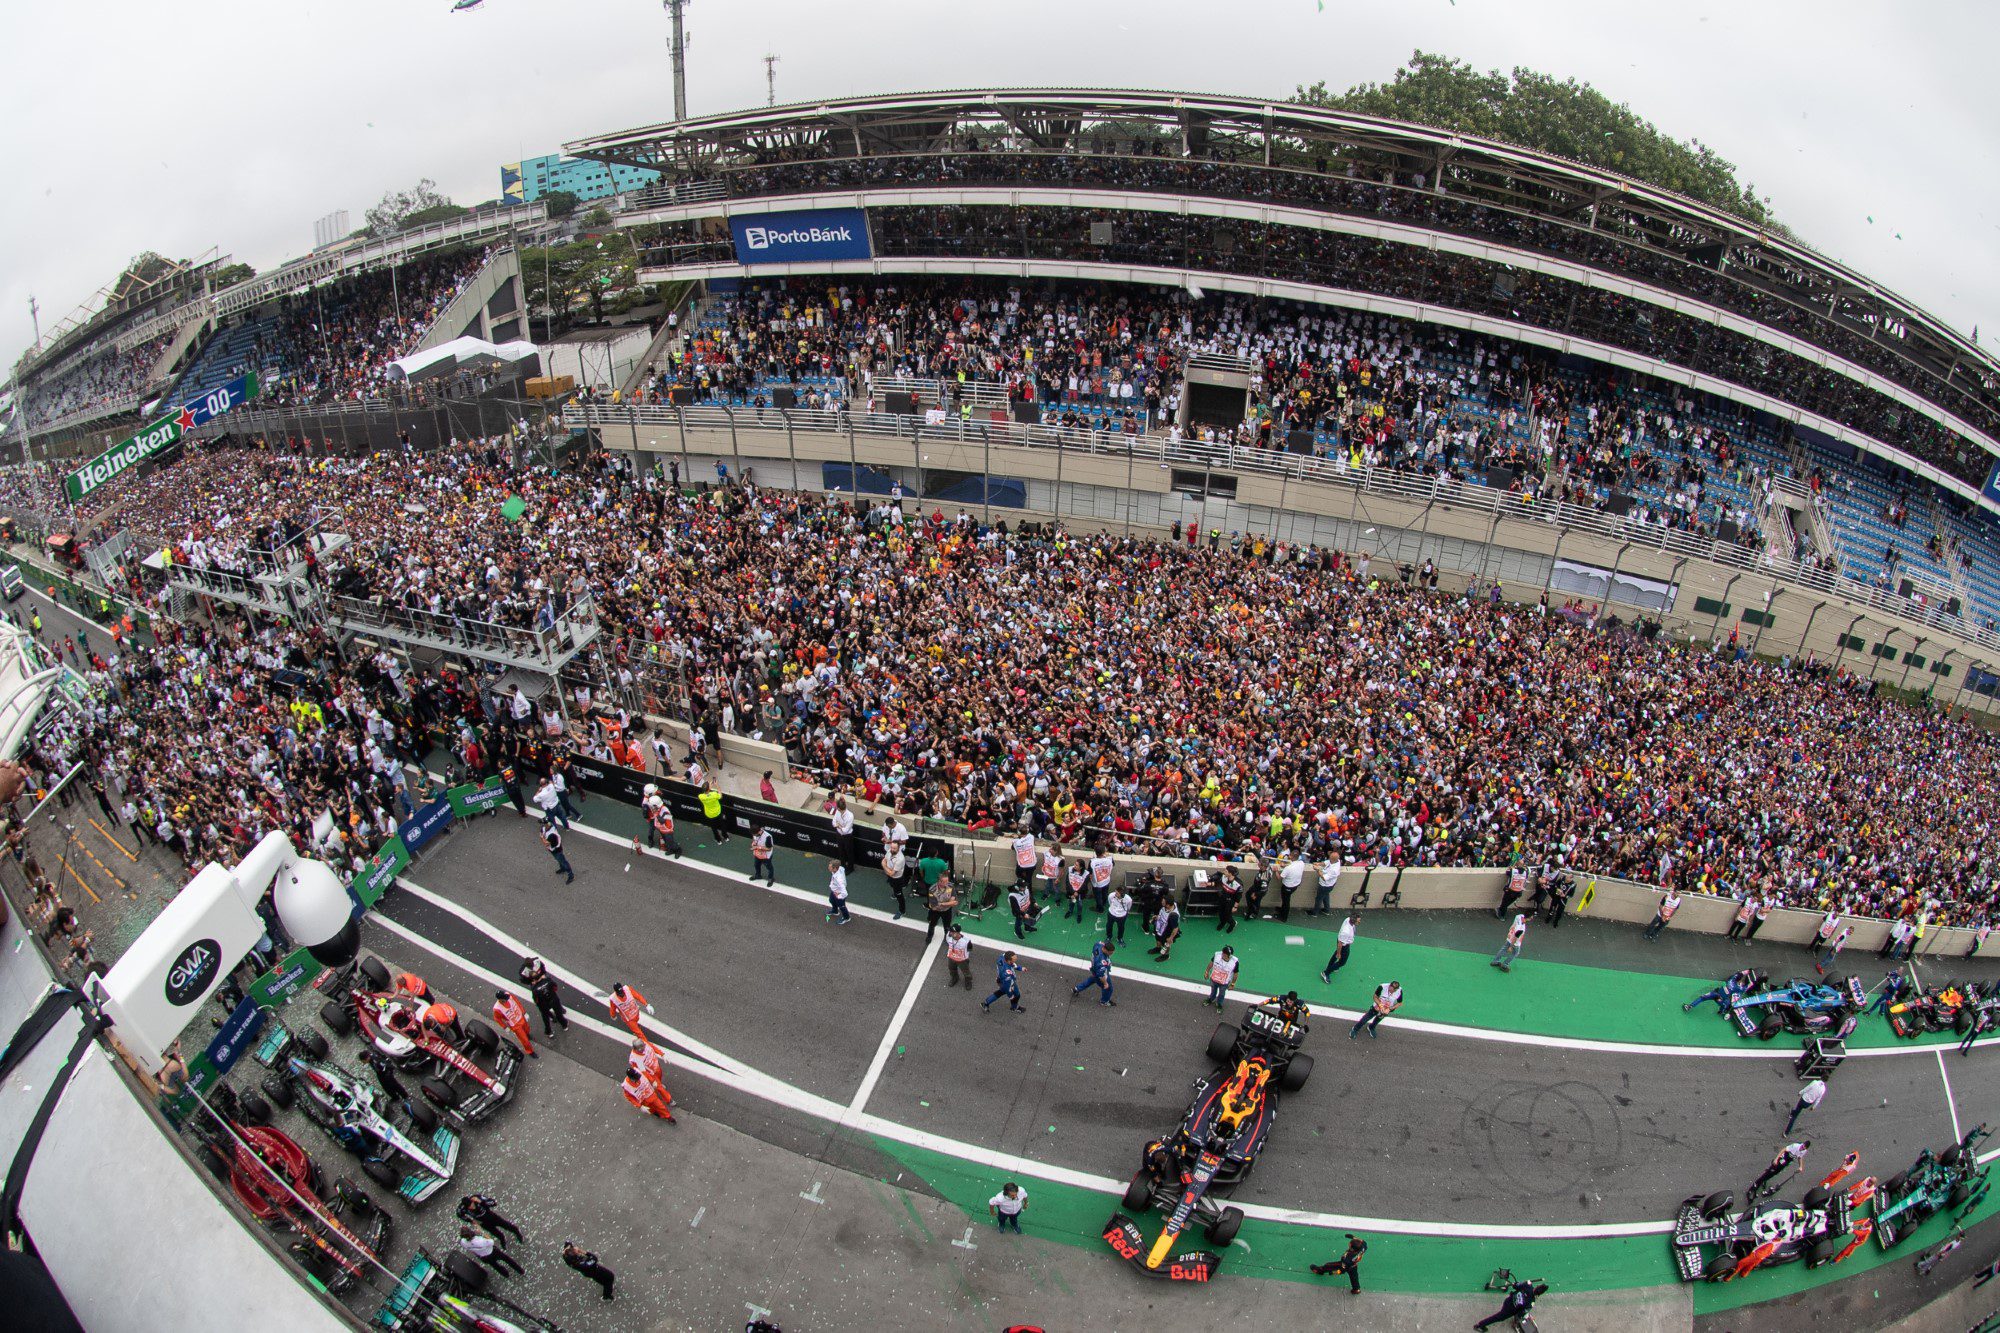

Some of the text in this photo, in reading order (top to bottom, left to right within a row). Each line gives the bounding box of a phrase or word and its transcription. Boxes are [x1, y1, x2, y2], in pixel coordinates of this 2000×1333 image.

[76, 423, 176, 494] Heineken
[436, 802, 451, 818] FERM
[464, 787, 505, 804] Heineken
[368, 855, 397, 889] Heineken
[170, 946, 210, 989] GWA
[178, 956, 215, 998] SYSTEMS
[266, 968, 304, 996] Heineken
[1185, 1192, 1195, 1204] 1
[1103, 1228, 1140, 1260] Red
[1170, 1264, 1208, 1282] Bull
